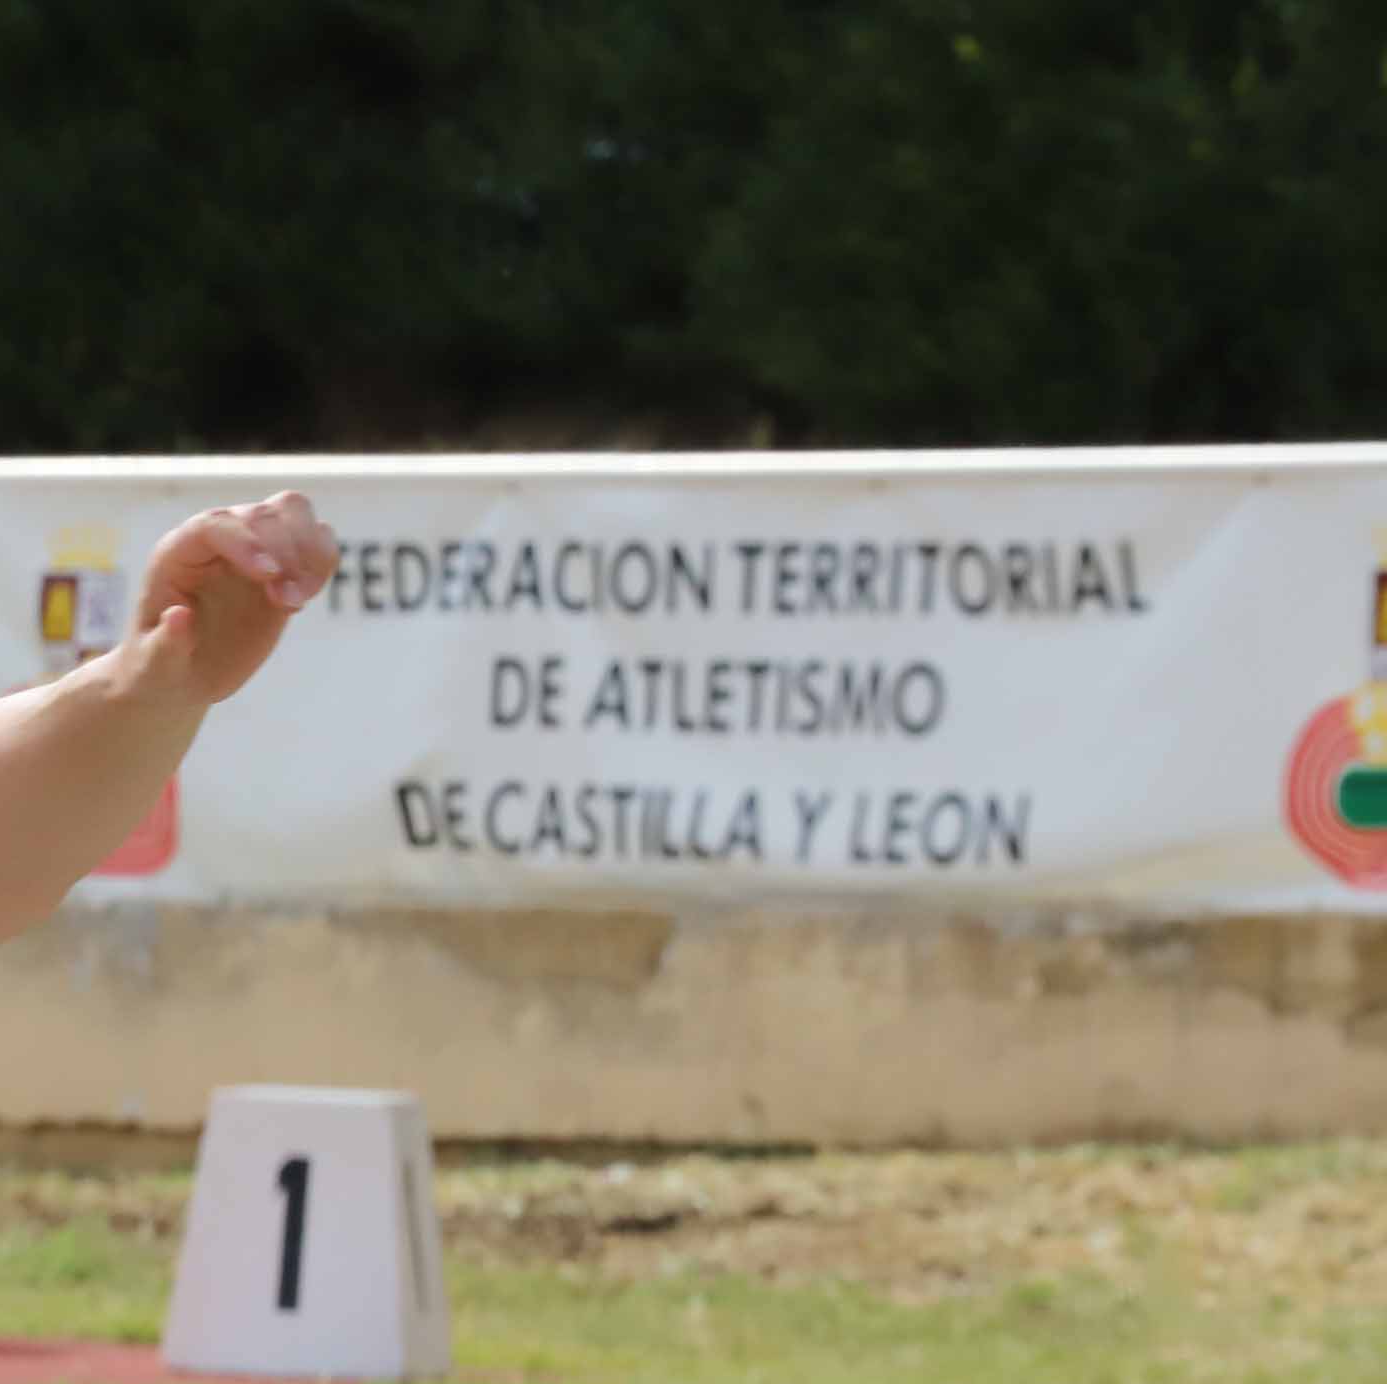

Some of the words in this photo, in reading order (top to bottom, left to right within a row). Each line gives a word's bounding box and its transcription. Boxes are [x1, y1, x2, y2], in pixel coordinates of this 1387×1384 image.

[328, 541, 712, 614] FEDERACION
[734, 541, 1150, 614] TERRITORIAL
[491, 655, 566, 729] DE
[584, 657, 946, 735] ATLETISMO
[395, 778, 472, 852] DE
[485, 780, 763, 861] CASTILLA
[793, 788, 831, 863] Y
[849, 790, 1033, 865] LEON
[277, 1155, 311, 1311] 1
